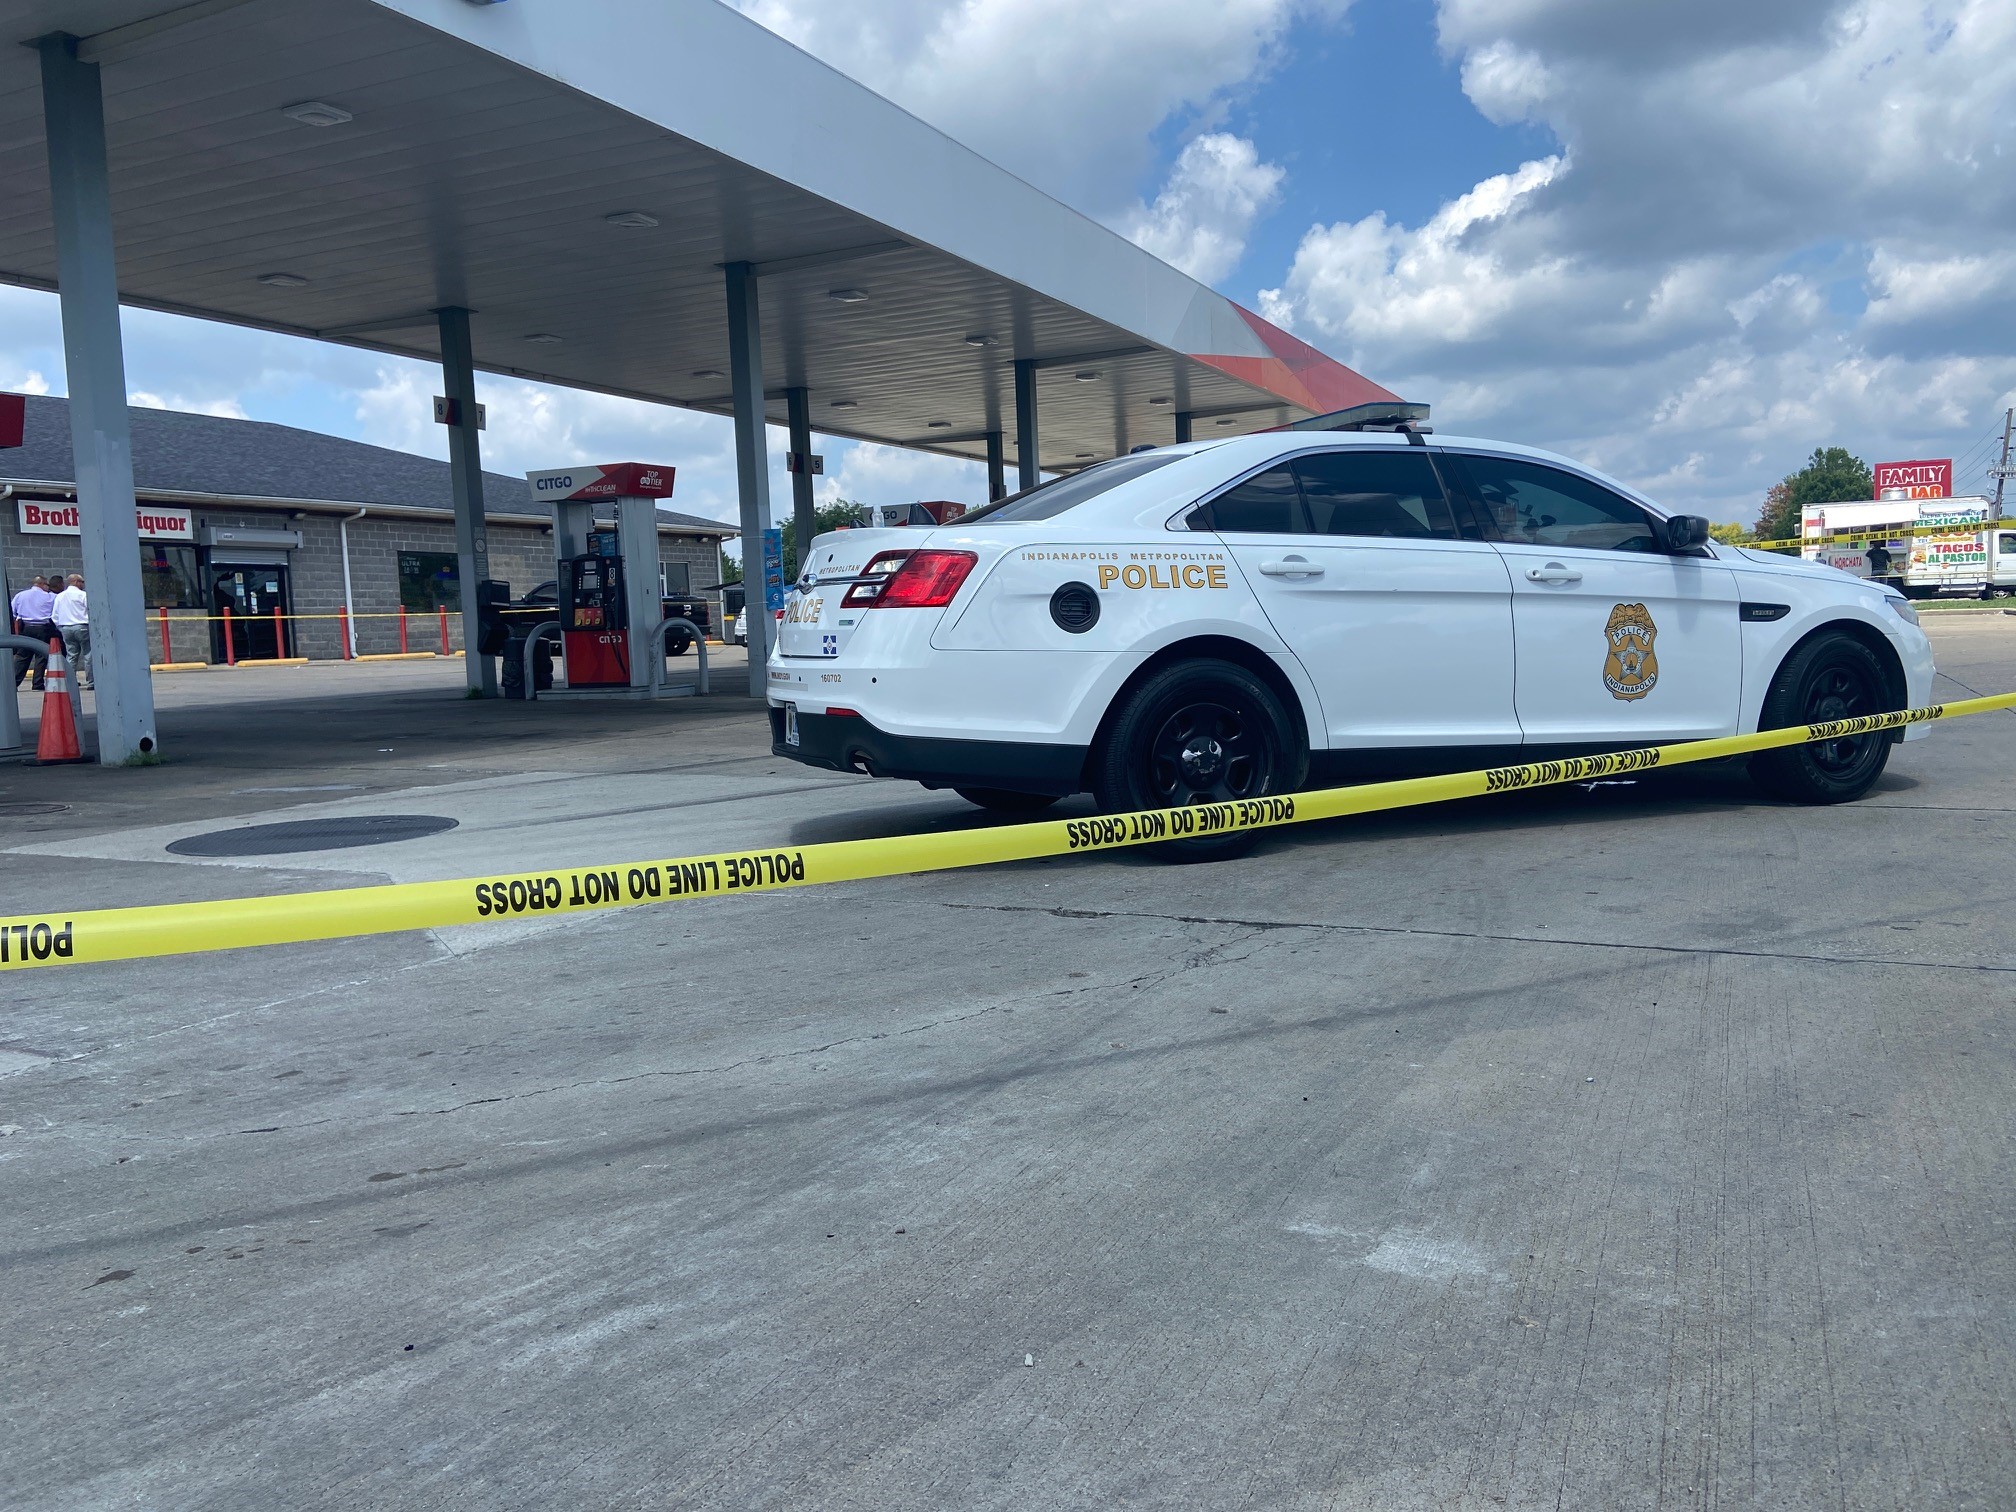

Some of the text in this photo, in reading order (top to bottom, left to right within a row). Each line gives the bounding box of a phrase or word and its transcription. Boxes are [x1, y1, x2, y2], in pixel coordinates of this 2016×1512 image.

[437, 403, 443, 415] 8
[478, 411, 483, 422] 7
[815, 460, 820, 469] 5
[647, 470, 659, 478] TOP
[1881, 465, 1946, 485] FAMILY
[536, 476, 572, 490] CITGO
[136, 511, 186, 534] iquor
[1912, 516, 1981, 526] MEXICAN
[1935, 543, 1984, 553] TACOS
[1022, 552, 1224, 561] INDIANAPOLIS METROPOLITAN
[1928, 553, 1986, 563] AL PASTOR
[1834, 557, 1862, 570] HORCHATA
[819, 565, 860, 575] METROPOLITAN
[1098, 565, 1228, 589] POLICE
[1615, 627, 1647, 639] POLICE
[821, 674, 841, 682] 160702
[1607, 675, 1655, 693] INDIANAPOLIS
[1486, 749, 1660, 791] POLICE LINE DO NOT CROSS
[1067, 797, 1295, 848] POLICE LINE DO NOT CROSS
[475, 852, 805, 916] POLICE LINE DO NOT CROSS
[1, 921, 73, 963] POLI
